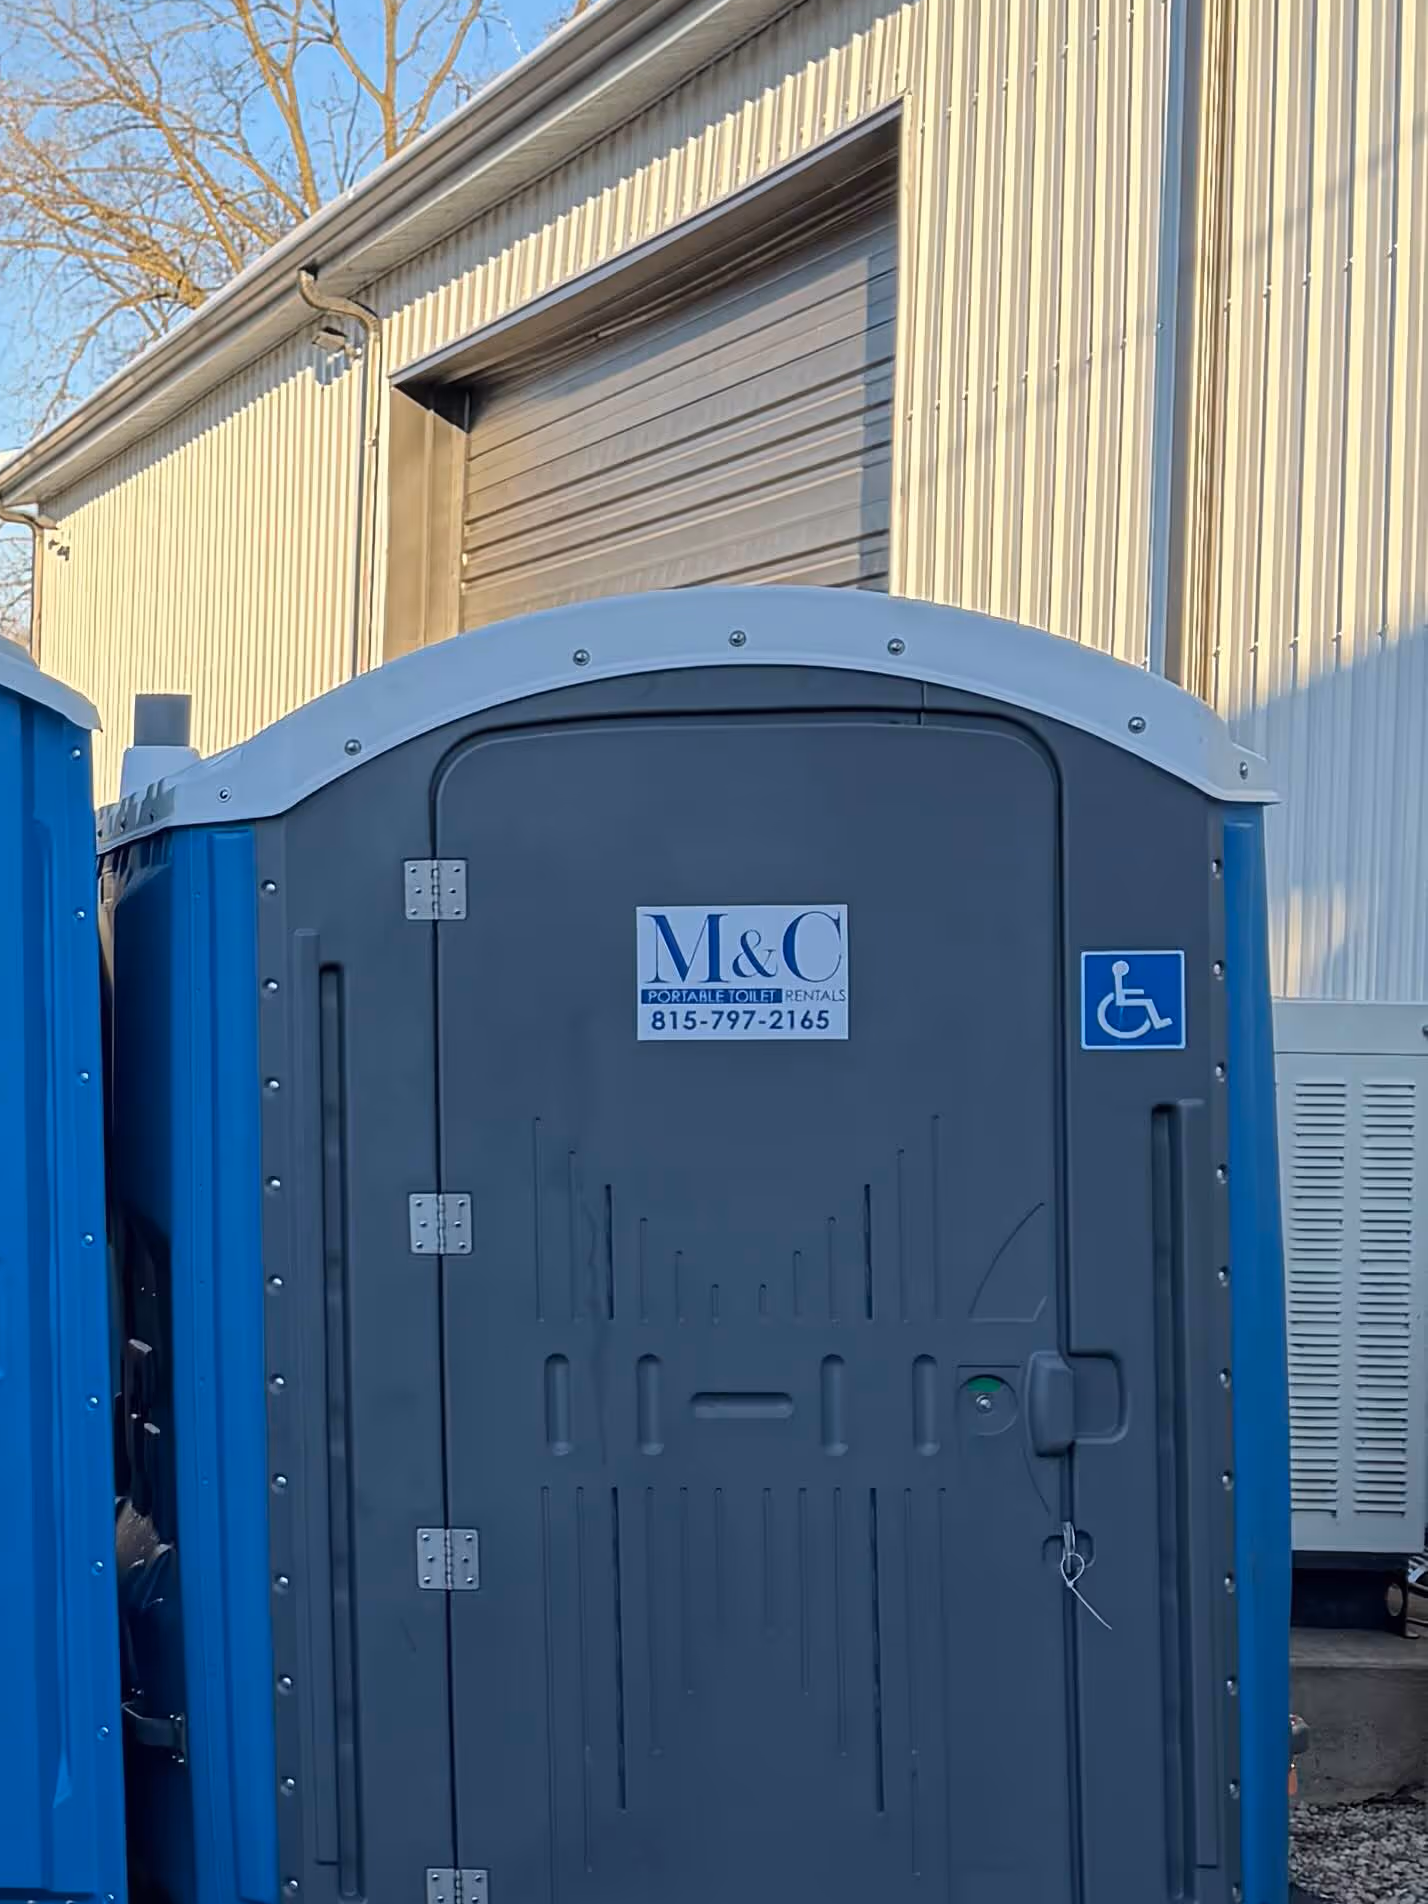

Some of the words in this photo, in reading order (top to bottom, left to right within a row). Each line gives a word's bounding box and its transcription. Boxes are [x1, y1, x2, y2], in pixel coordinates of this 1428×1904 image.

[644, 911, 842, 983] M&C
[647, 990, 724, 1003] PORTABLE
[728, 990, 775, 1003] TOILET
[784, 989, 847, 1002] RENTALS
[651, 1010, 830, 1030] 815-797-2165
